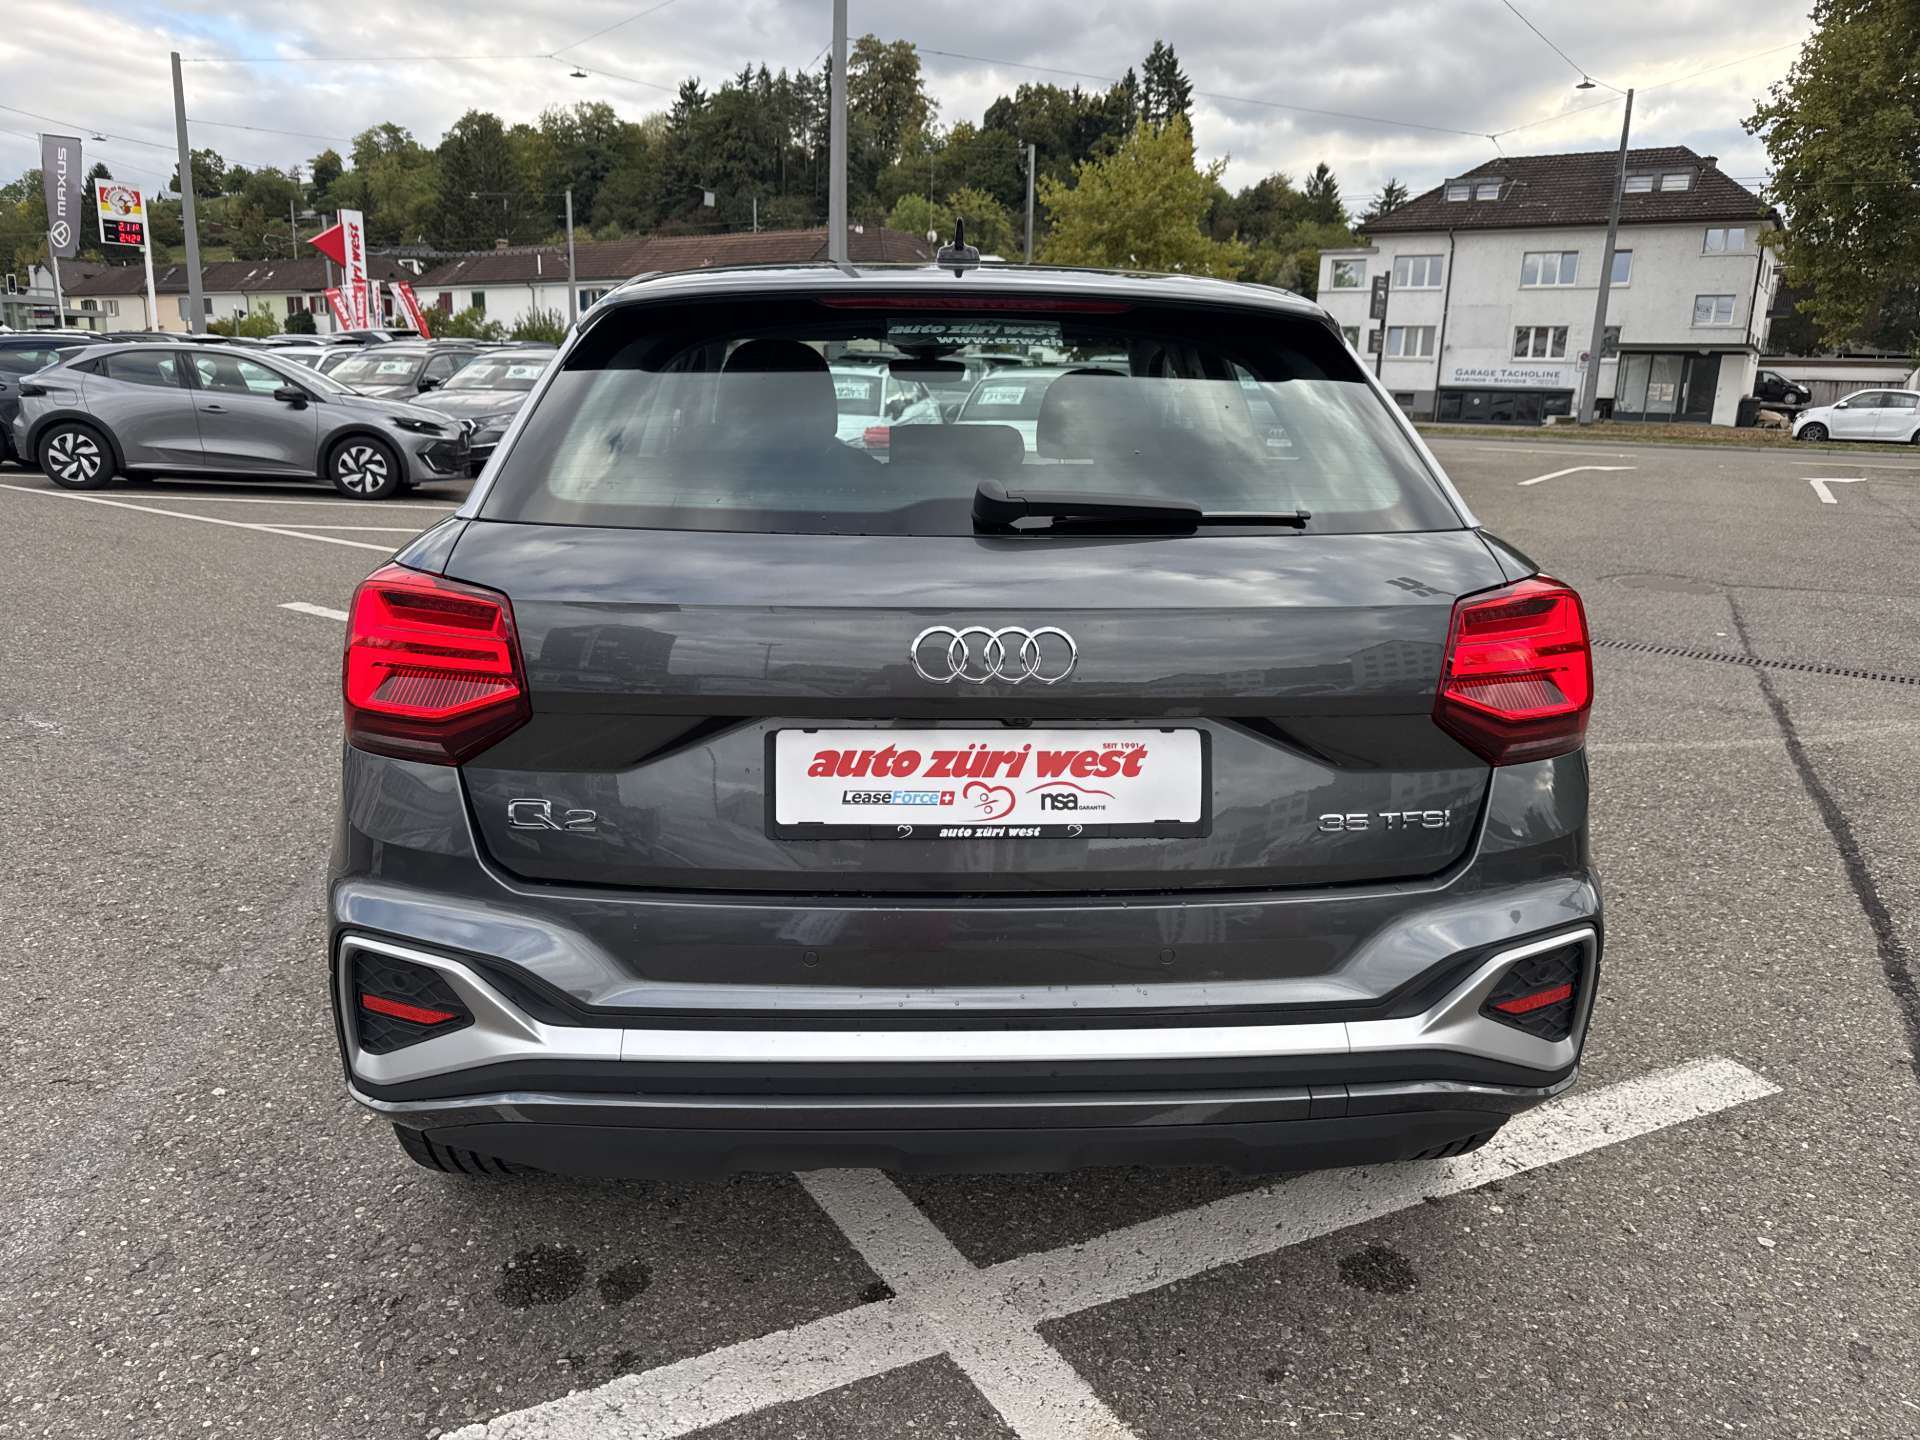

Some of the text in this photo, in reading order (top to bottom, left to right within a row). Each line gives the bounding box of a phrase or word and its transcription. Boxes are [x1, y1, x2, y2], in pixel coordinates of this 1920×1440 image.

[57, 146, 67, 216] MAXUS
[348, 222, 361, 262] west
[888, 324, 947, 334] auto
[1004, 325, 1061, 336] west
[937, 336, 1064, 347] www.azw.ch
[1455, 368, 1561, 379] GARAGE TACHOLINE
[807, 743, 1149, 778] auto züri west
[842, 790, 940, 805] LeaseForce
[1041, 792, 1078, 811] nsa
[508, 798, 597, 832] Q2
[1318, 809, 1451, 832] 35 TFSI
[939, 825, 1042, 838] auto züri west
